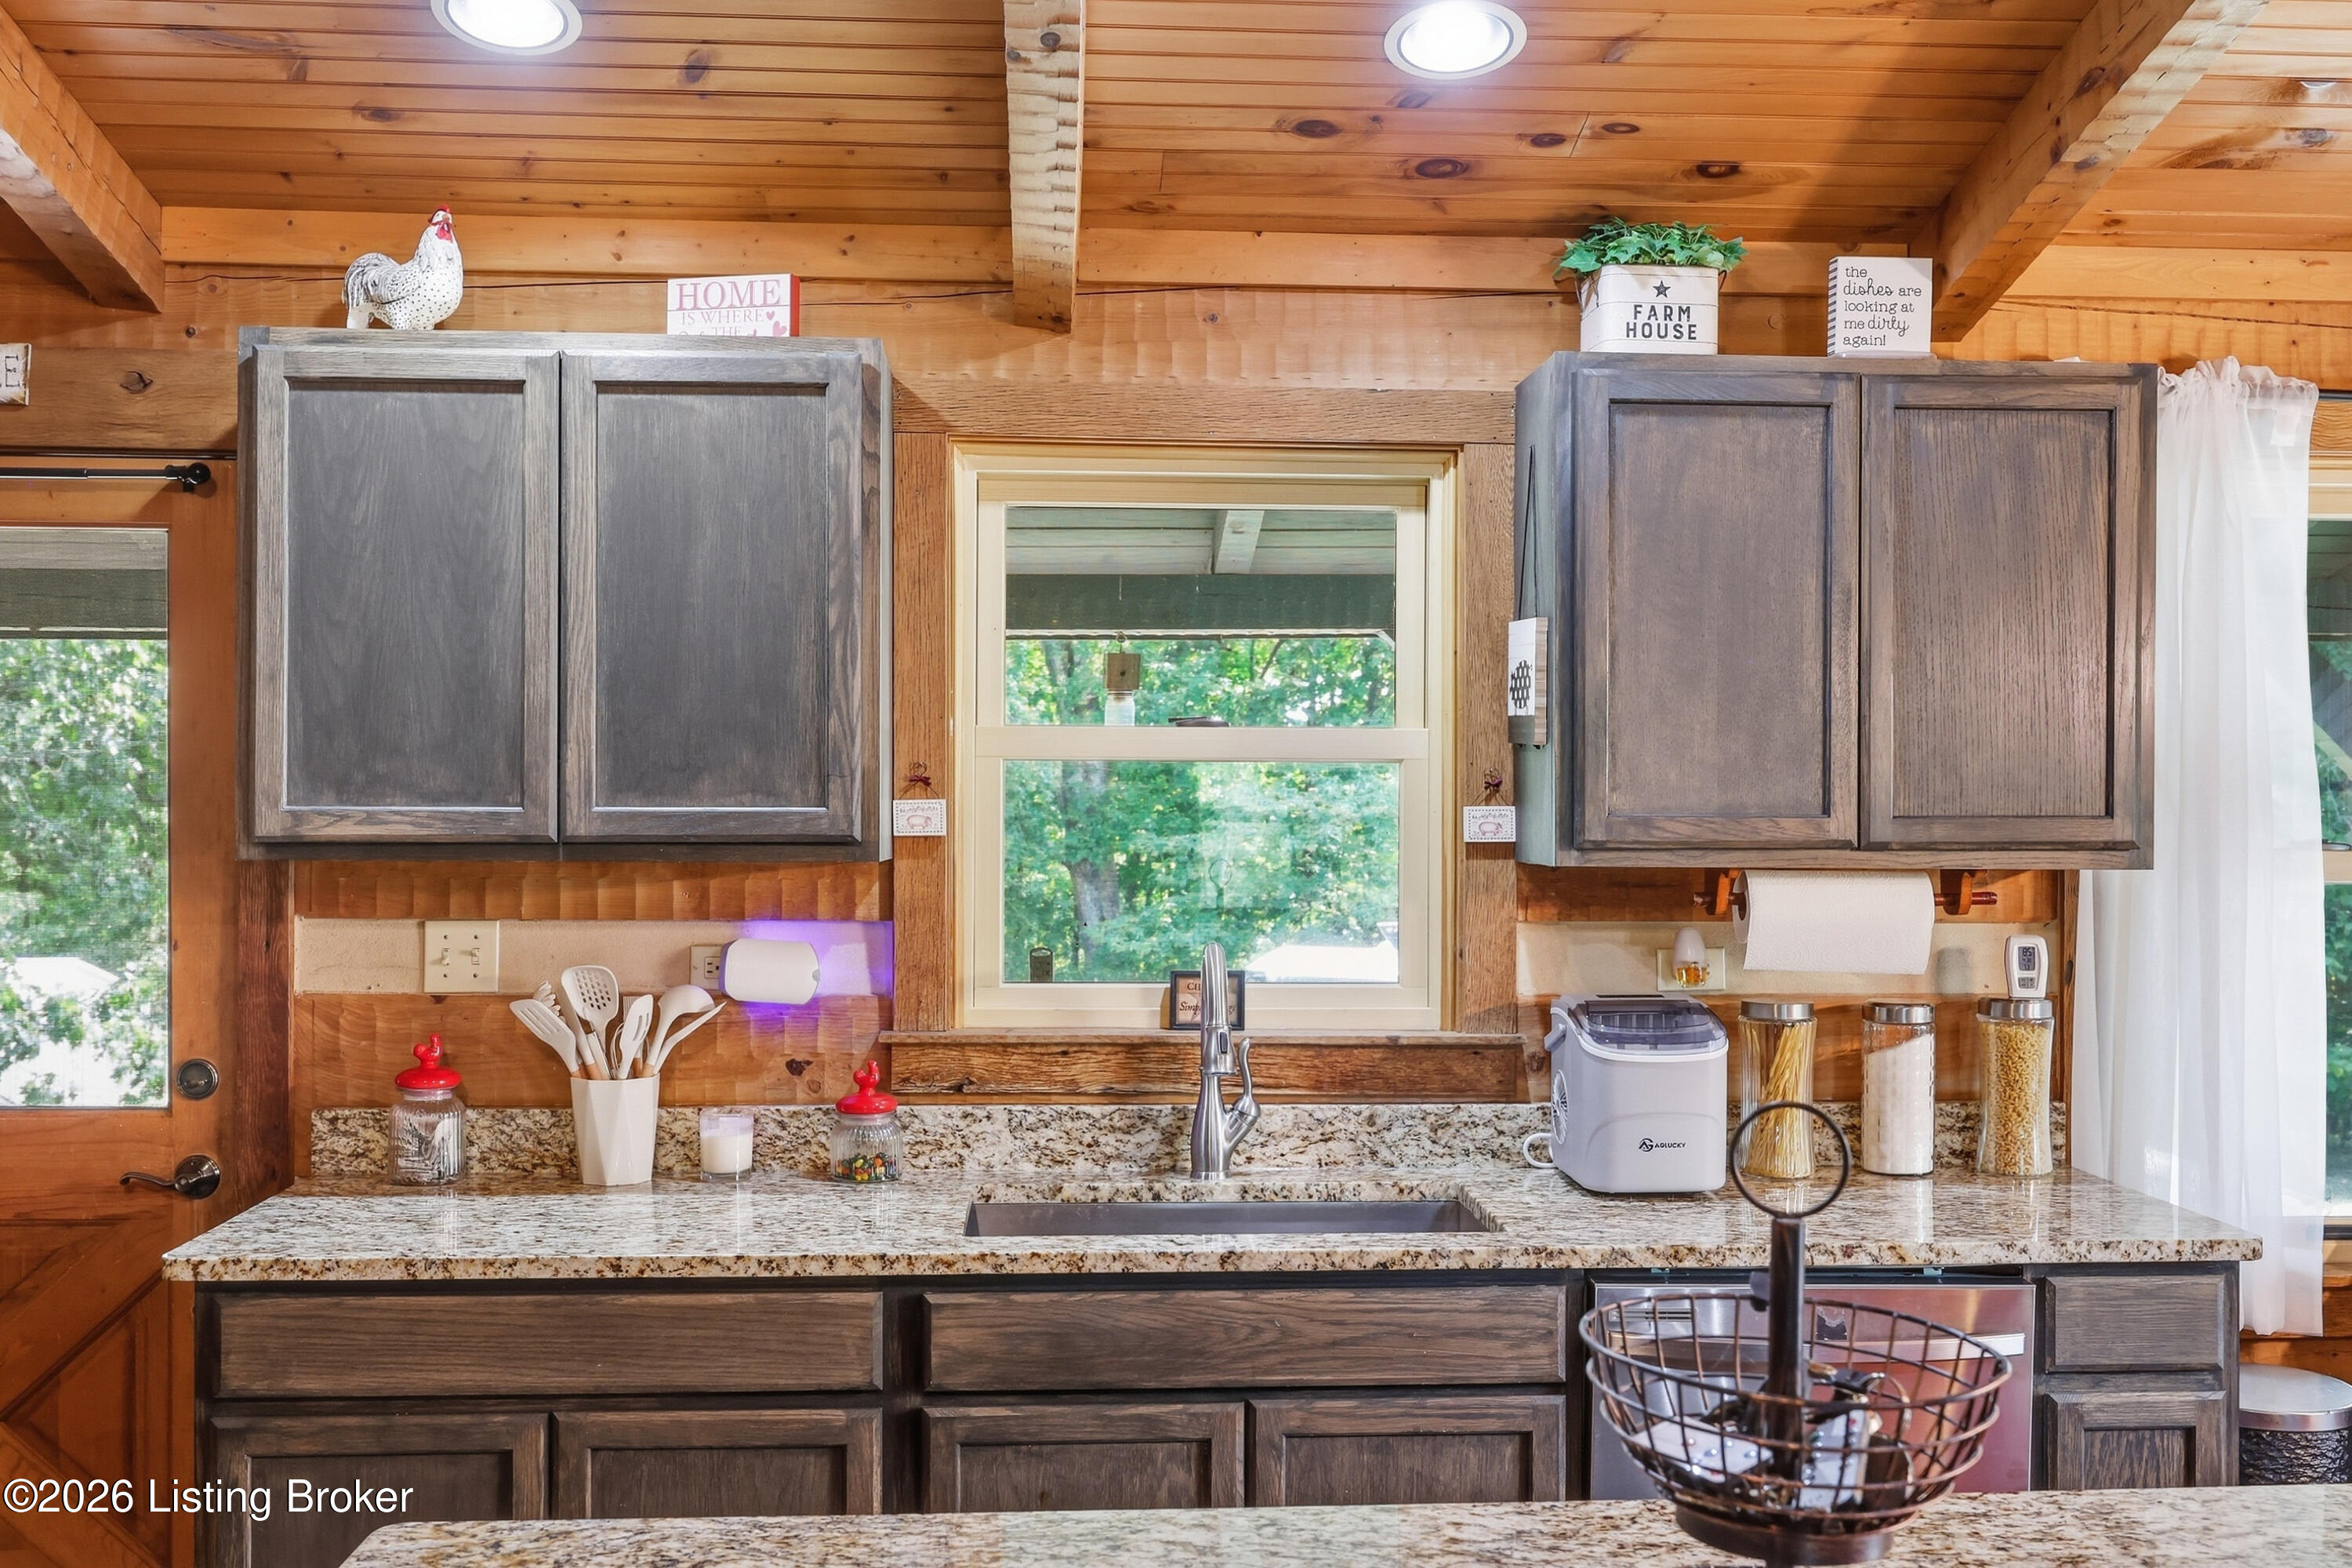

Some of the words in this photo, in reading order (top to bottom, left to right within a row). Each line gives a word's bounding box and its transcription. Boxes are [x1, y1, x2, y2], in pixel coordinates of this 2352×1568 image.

[1846, 267, 1867, 278] the
[676, 279, 781, 310] HOME
[1843, 278, 1893, 296] dishes
[1898, 287, 1922, 296] are
[1633, 304, 1691, 322] FARM
[1844, 300, 1897, 314] looking
[1900, 303, 1915, 313] at
[681, 311, 695, 325] IS
[700, 309, 764, 324] WHERE
[1844, 319, 1864, 329] me
[1867, 314, 1909, 337] dirty
[1625, 321, 1697, 340] HOUSE
[1842, 335, 1886, 348] again!
